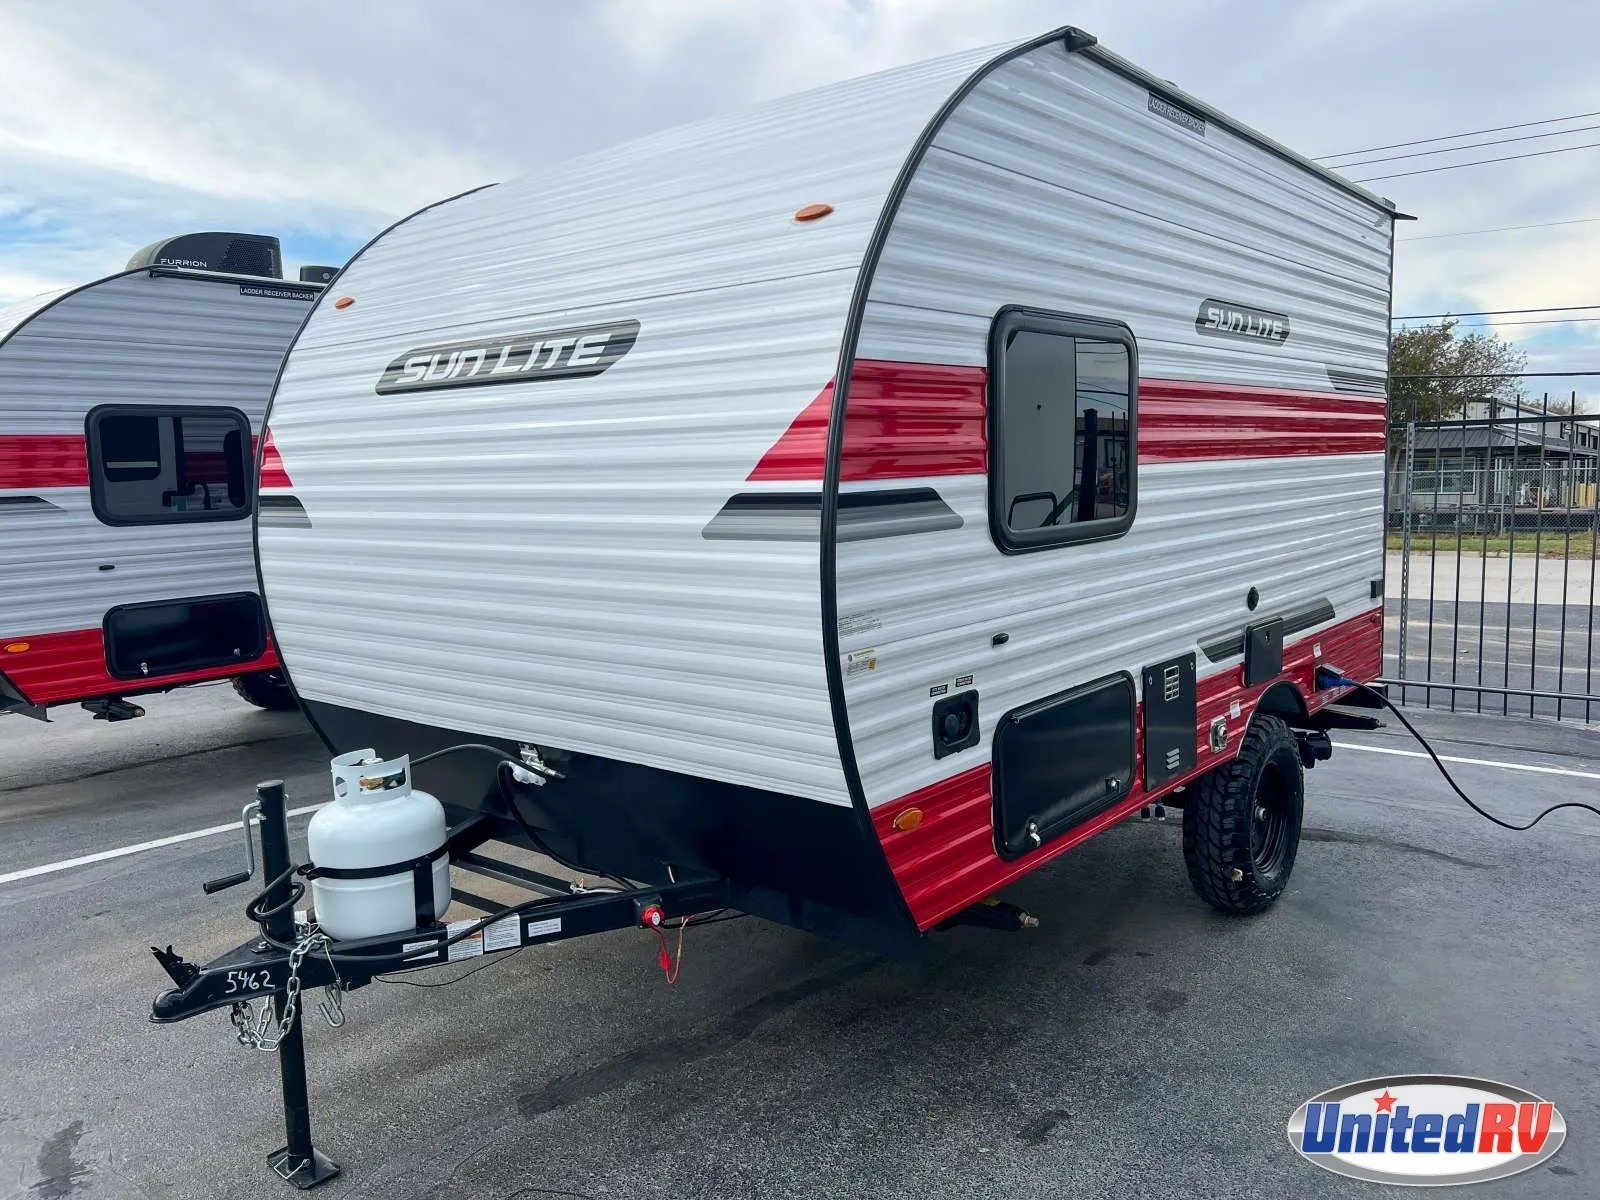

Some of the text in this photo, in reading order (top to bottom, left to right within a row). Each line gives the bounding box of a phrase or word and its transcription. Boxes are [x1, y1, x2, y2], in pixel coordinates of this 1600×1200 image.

[160, 258, 207, 268] FURRION
[240, 287, 263, 295] LADDER
[1204, 307, 1283, 340] SUN LITE
[396, 333, 612, 384] SUN LITE
[225, 970, 276, 993] 5462
